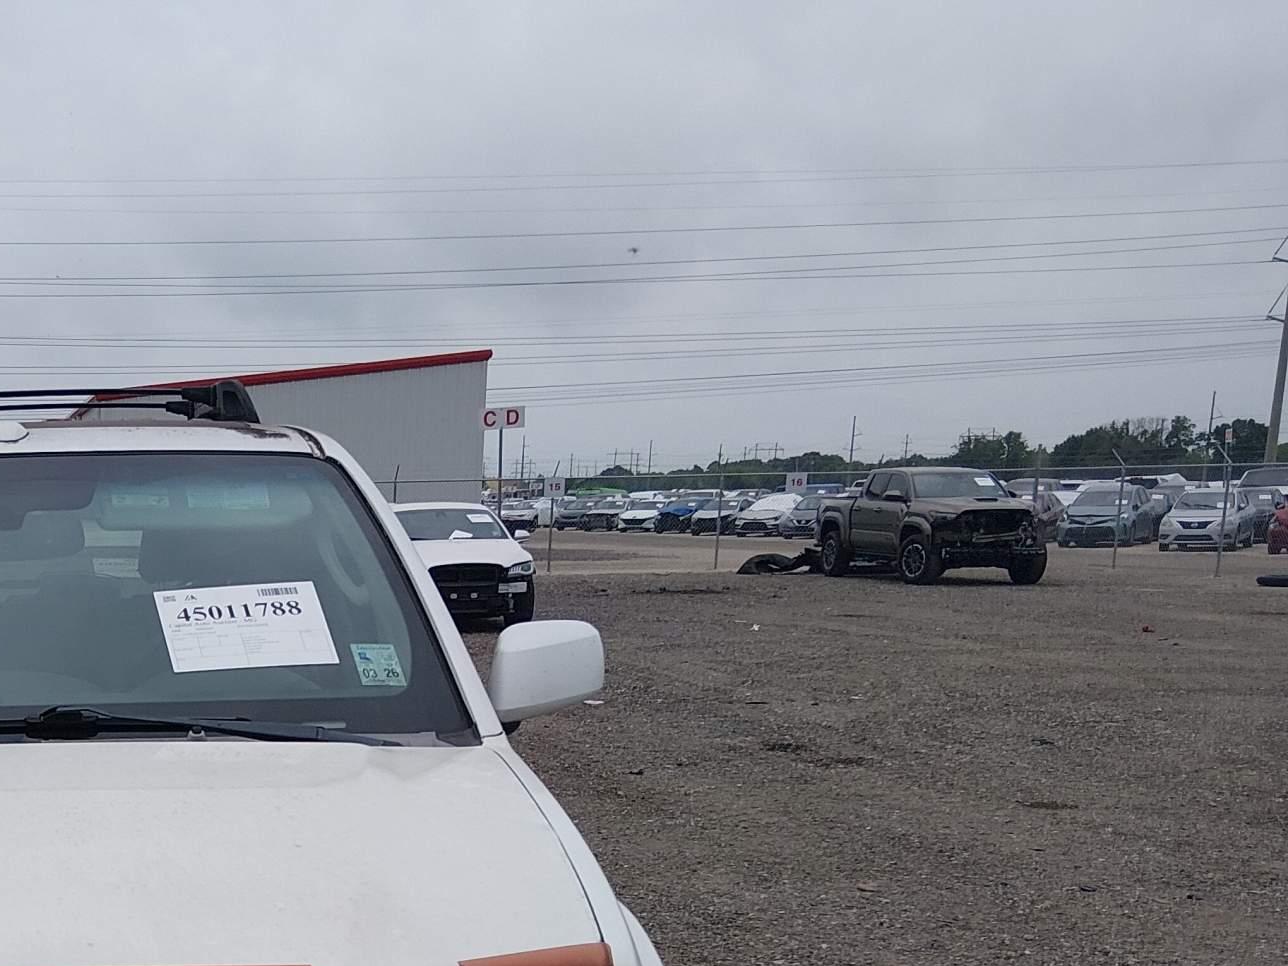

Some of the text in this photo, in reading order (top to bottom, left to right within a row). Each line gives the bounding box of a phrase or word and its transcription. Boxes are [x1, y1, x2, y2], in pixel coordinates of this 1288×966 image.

[483, 409, 520, 427] C D
[549, 482, 561, 491] 15
[176, 600, 302, 622] 45011788
[362, 667, 400, 679] 03 26
